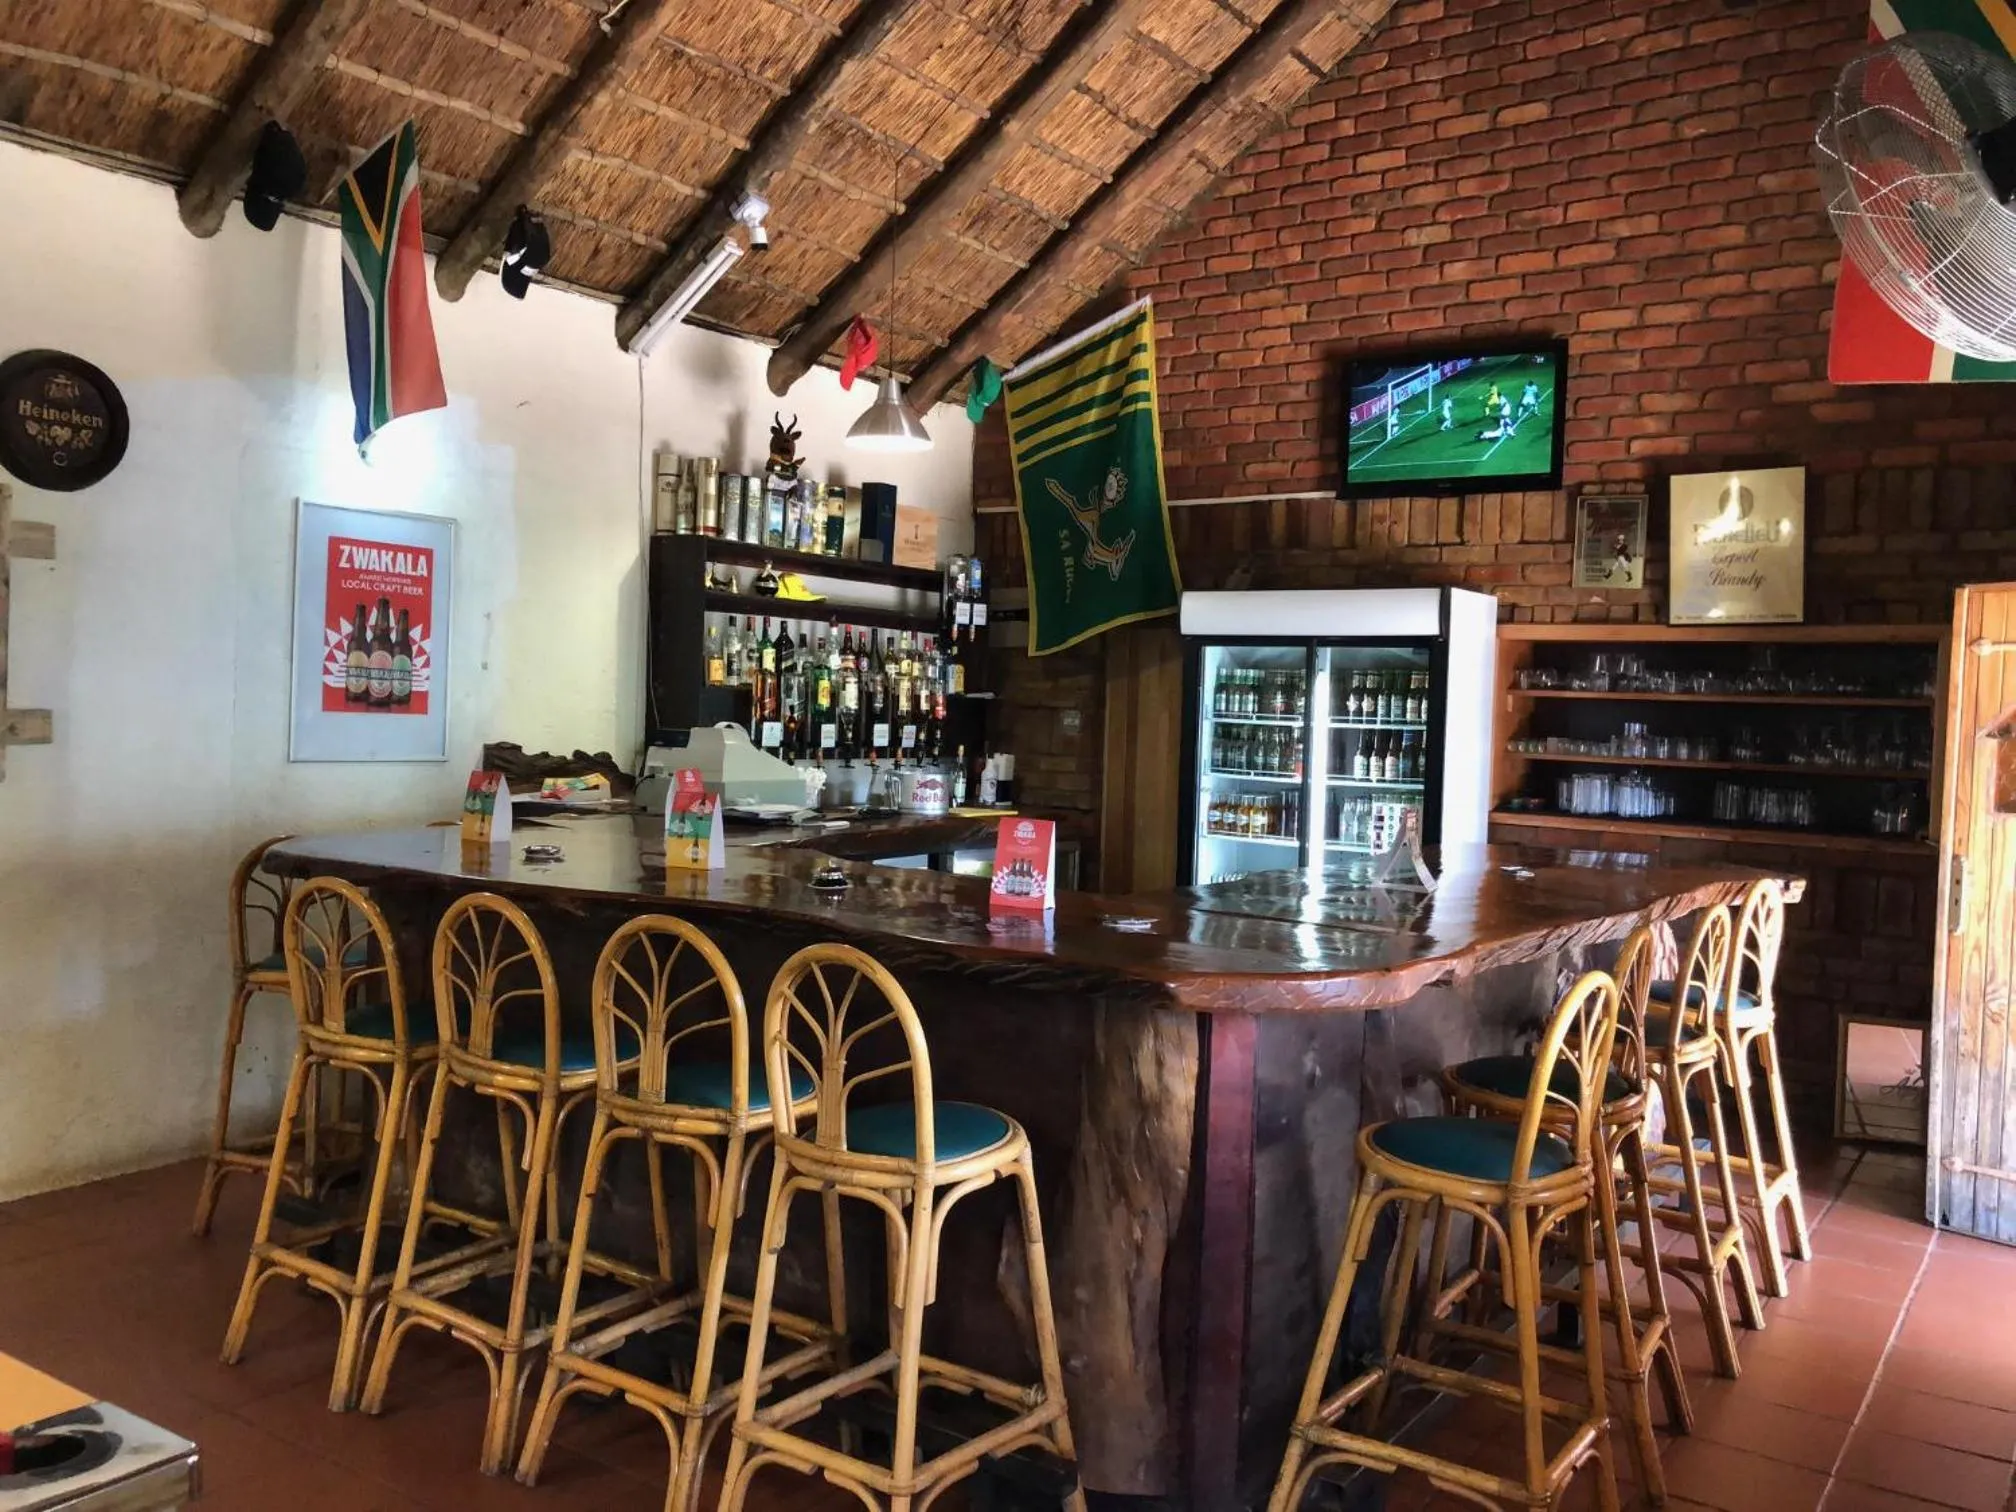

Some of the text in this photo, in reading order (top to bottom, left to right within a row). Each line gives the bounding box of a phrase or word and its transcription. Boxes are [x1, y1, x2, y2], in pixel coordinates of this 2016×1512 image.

[18, 399, 103, 428] Heineken
[339, 544, 428, 577] ZWAKALA
[341, 579, 424, 596] LOCAL CRAFT BEER
